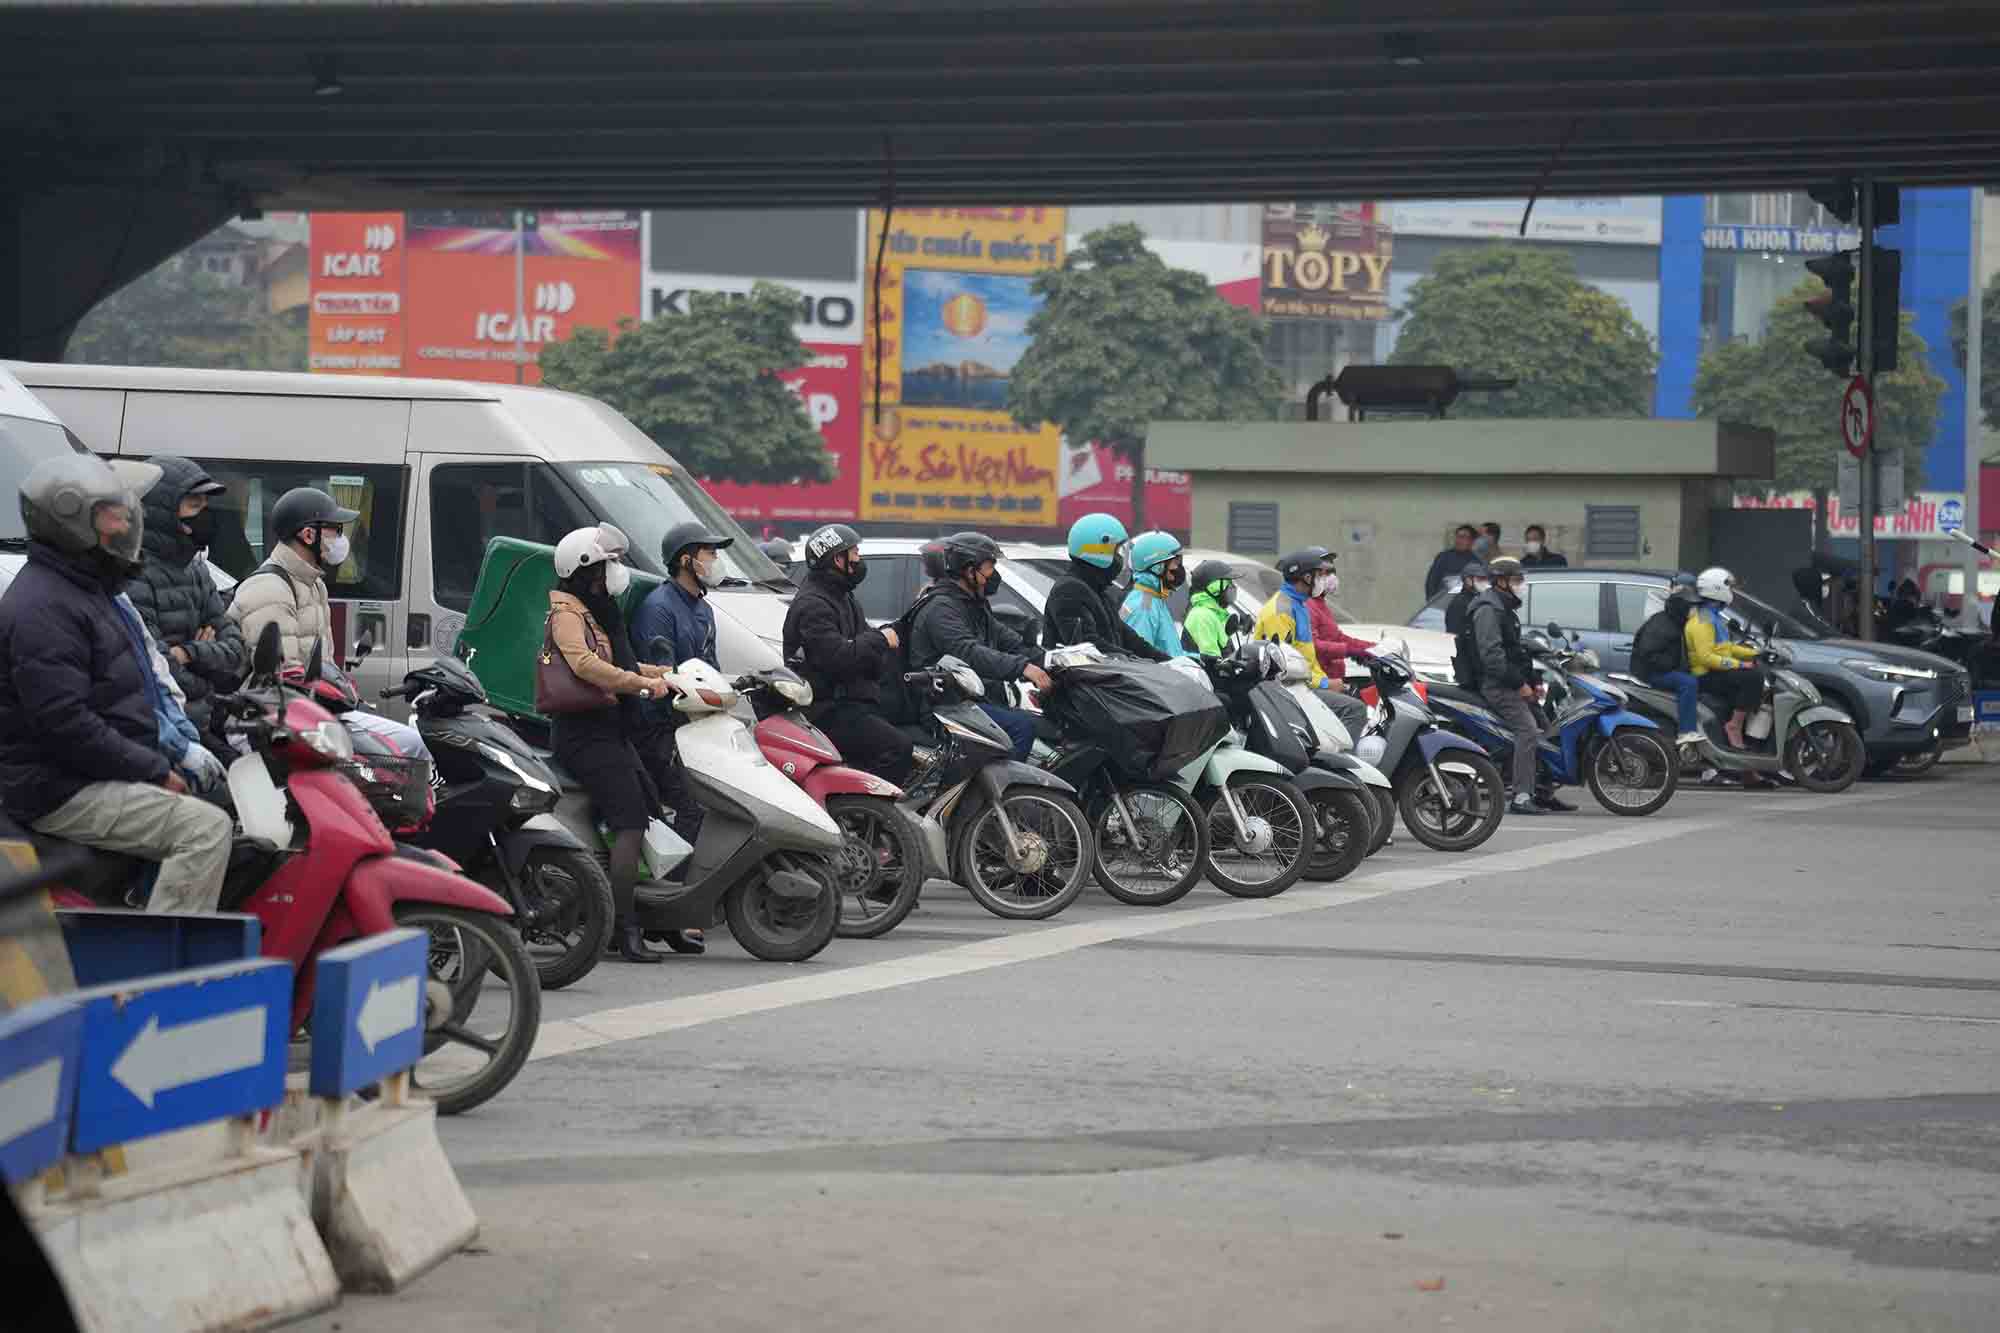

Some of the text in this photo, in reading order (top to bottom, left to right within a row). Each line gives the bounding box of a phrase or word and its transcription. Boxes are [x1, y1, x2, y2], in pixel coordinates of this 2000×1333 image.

[1743, 229, 1790, 251] KHOA
[322, 254, 382, 277] ICAR
[1264, 248, 1392, 293] TOPY
[475, 312, 556, 342] ICAR
